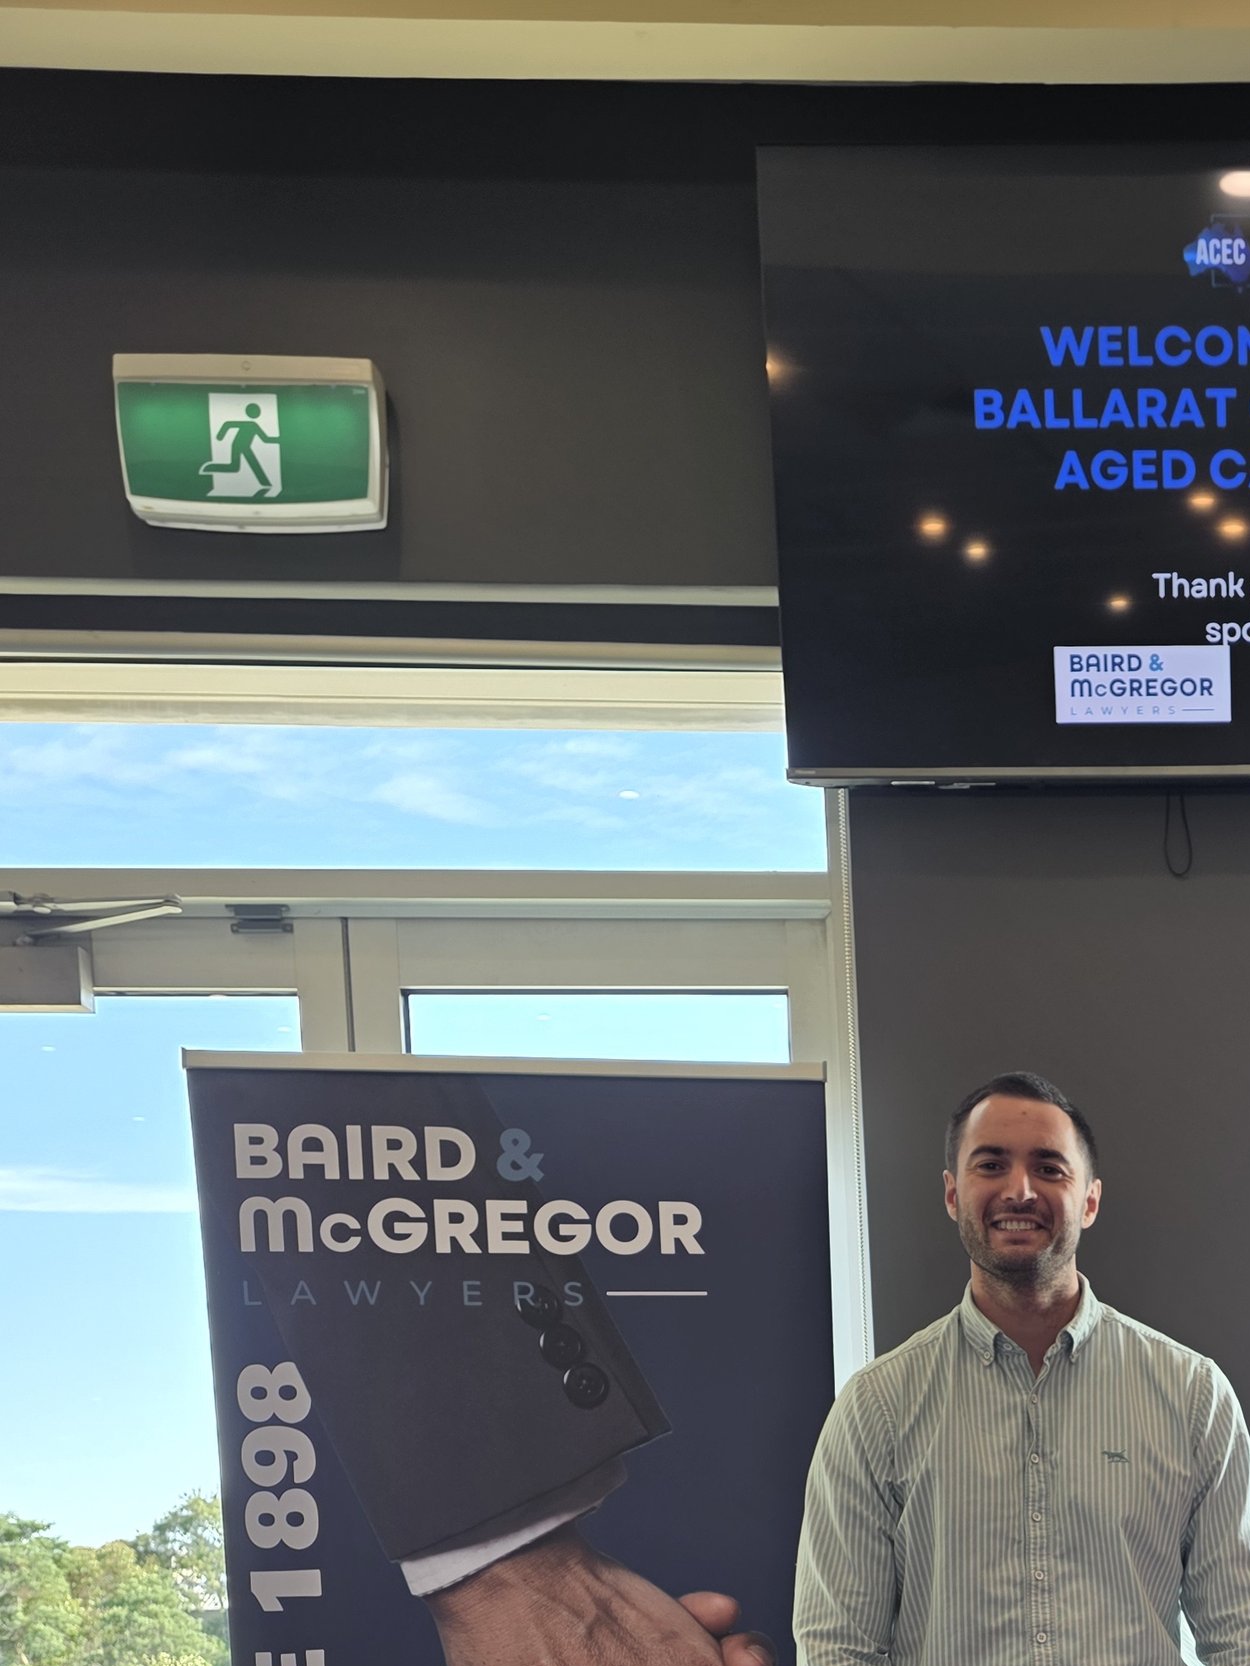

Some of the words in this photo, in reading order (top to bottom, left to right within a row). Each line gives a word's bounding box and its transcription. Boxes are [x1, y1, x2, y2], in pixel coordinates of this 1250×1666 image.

[1196, 238, 1246, 265] ACEC
[974, 388, 1237, 429] BALLARAT
[1054, 450, 1196, 490] AGED
[1152, 573, 1244, 599] Thank
[1069, 654, 1142, 673] BAIRD
[1149, 654, 1164, 671] &
[1069, 678, 1213, 698] McGREGOR
[1070, 706, 1176, 716] LAWYERS
[233, 1123, 476, 1181] BAIRD
[496, 1128, 545, 1182] &
[239, 1196, 705, 1255] McGREGOR
[243, 1280, 584, 1307] LAWYERS
[237, 1361, 322, 1612] 1898
